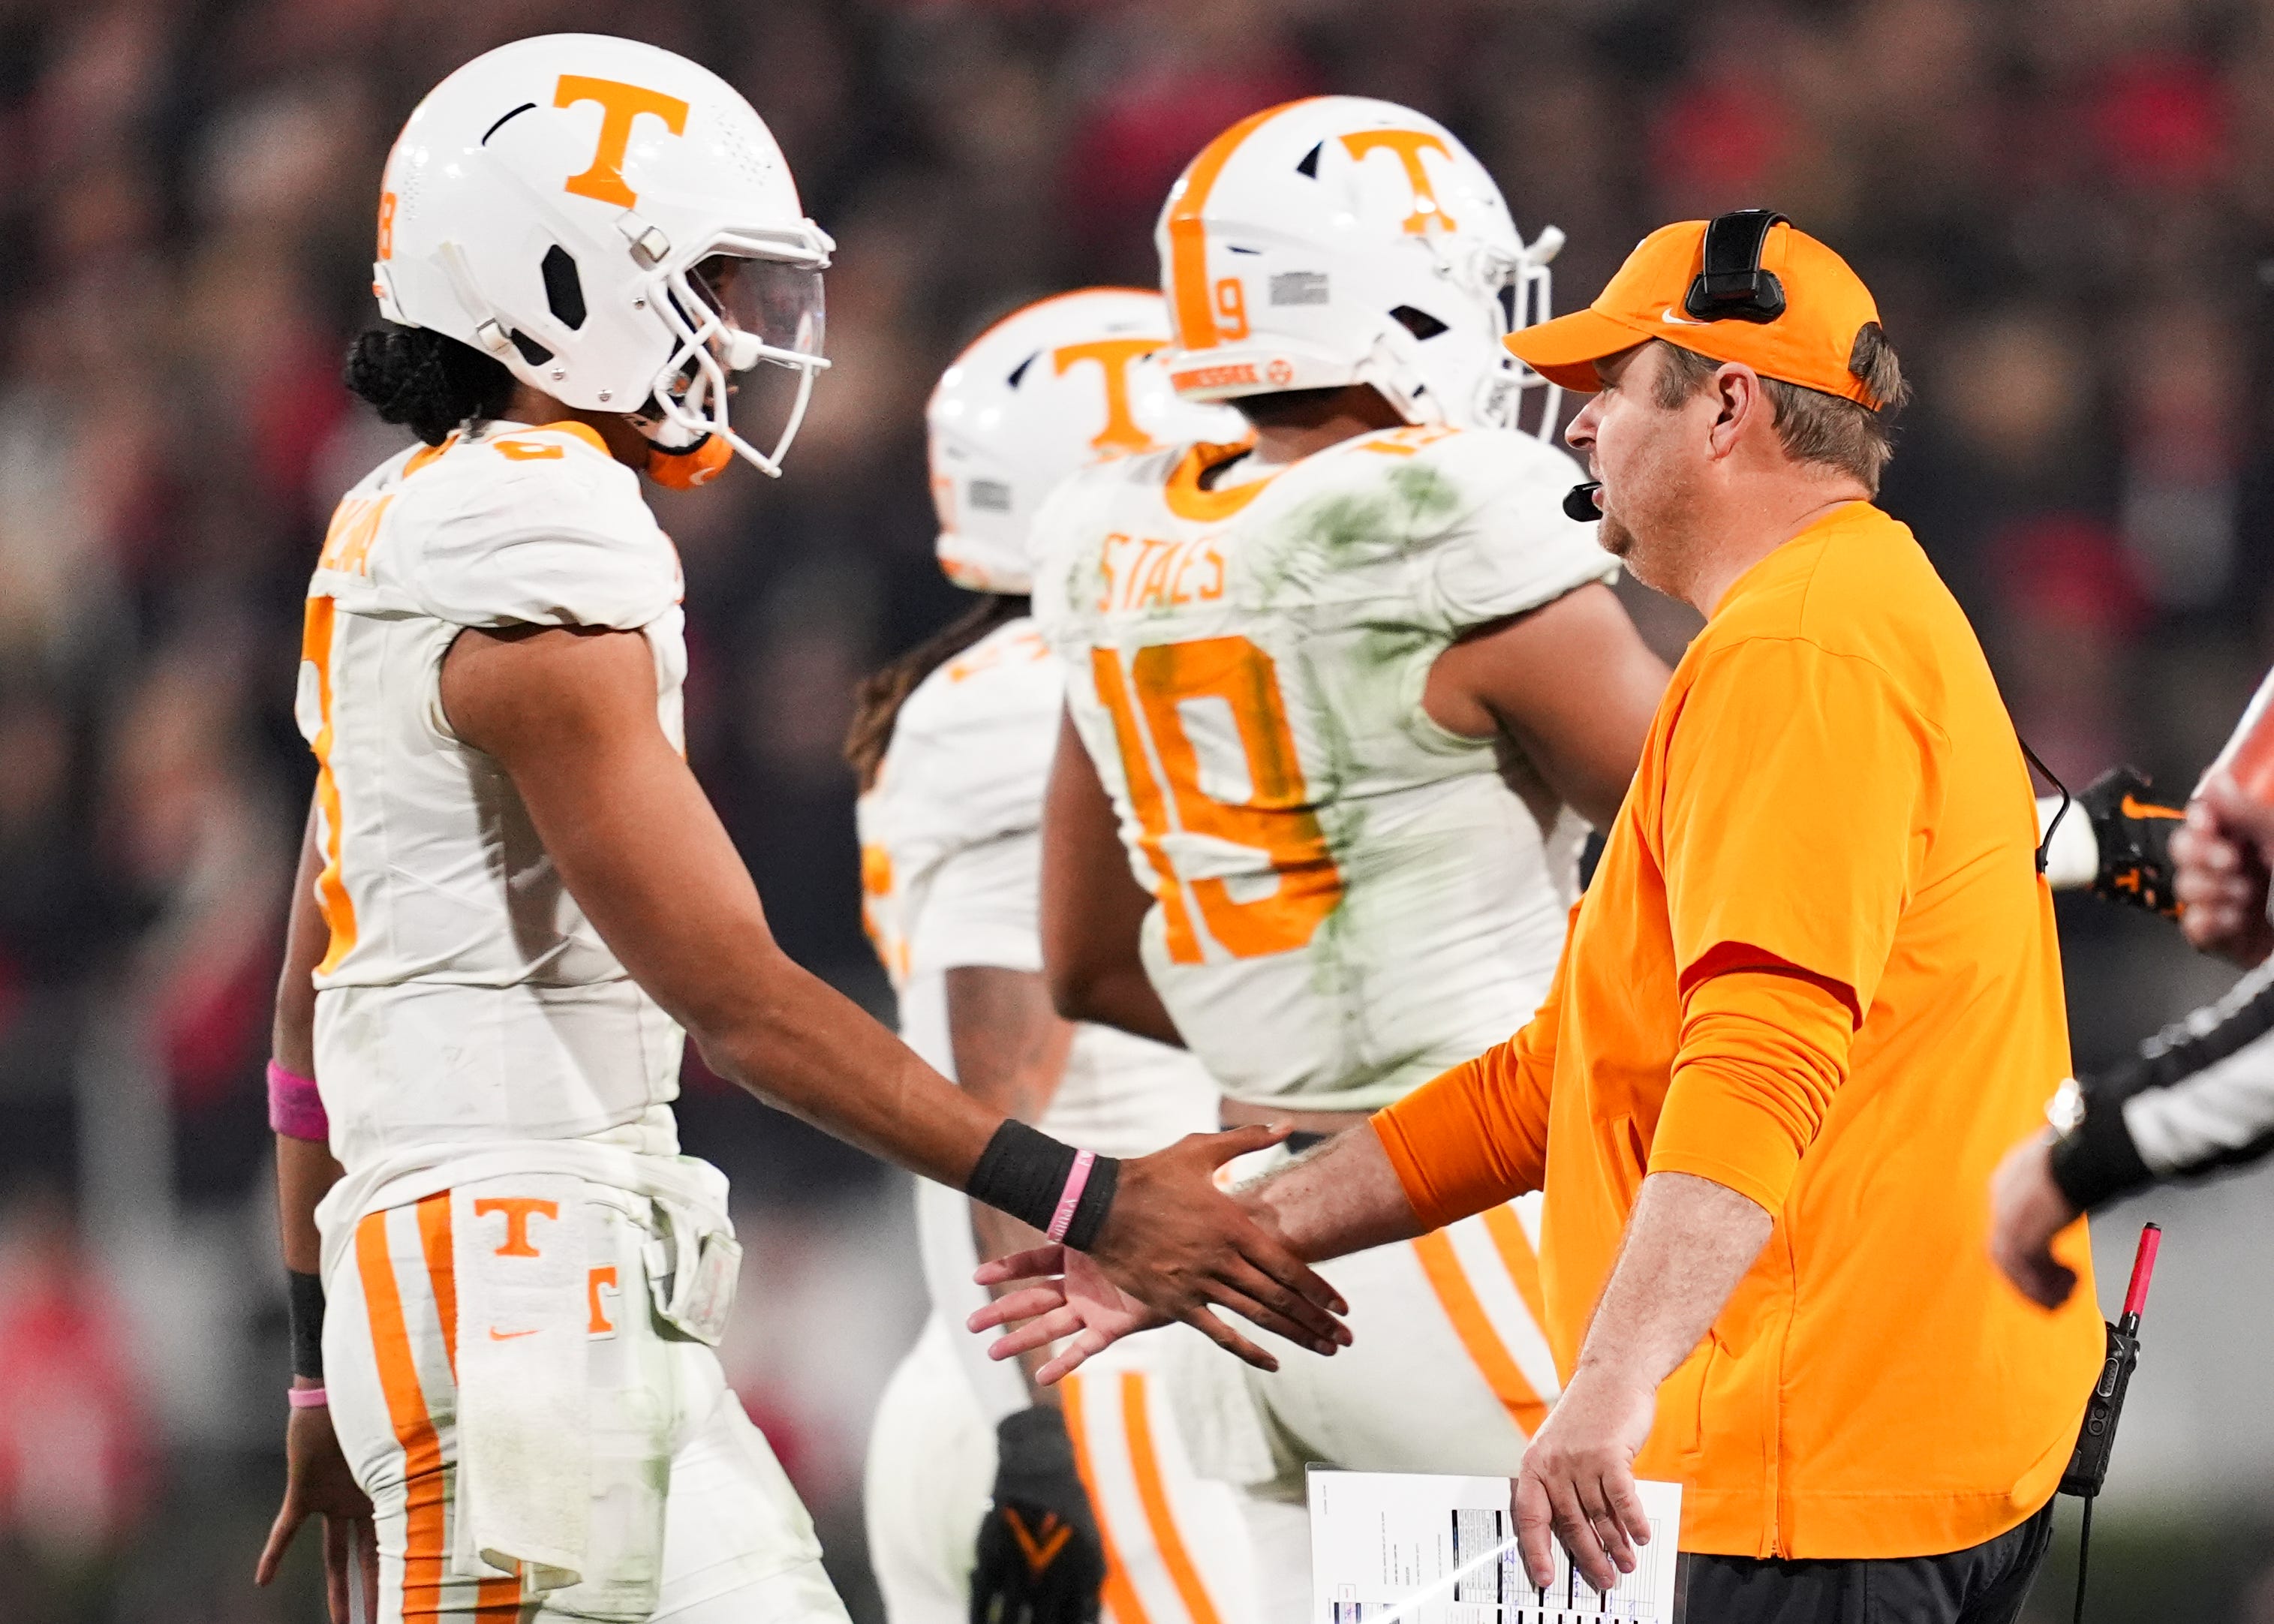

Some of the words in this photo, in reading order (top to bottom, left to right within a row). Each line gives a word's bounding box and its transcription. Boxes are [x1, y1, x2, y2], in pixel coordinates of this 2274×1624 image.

[554, 74, 690, 210] T
[1340, 129, 1457, 234] T
[1216, 278, 1251, 341] 9
[1053, 339, 1171, 455] T
[474, 1197, 559, 1258] T
